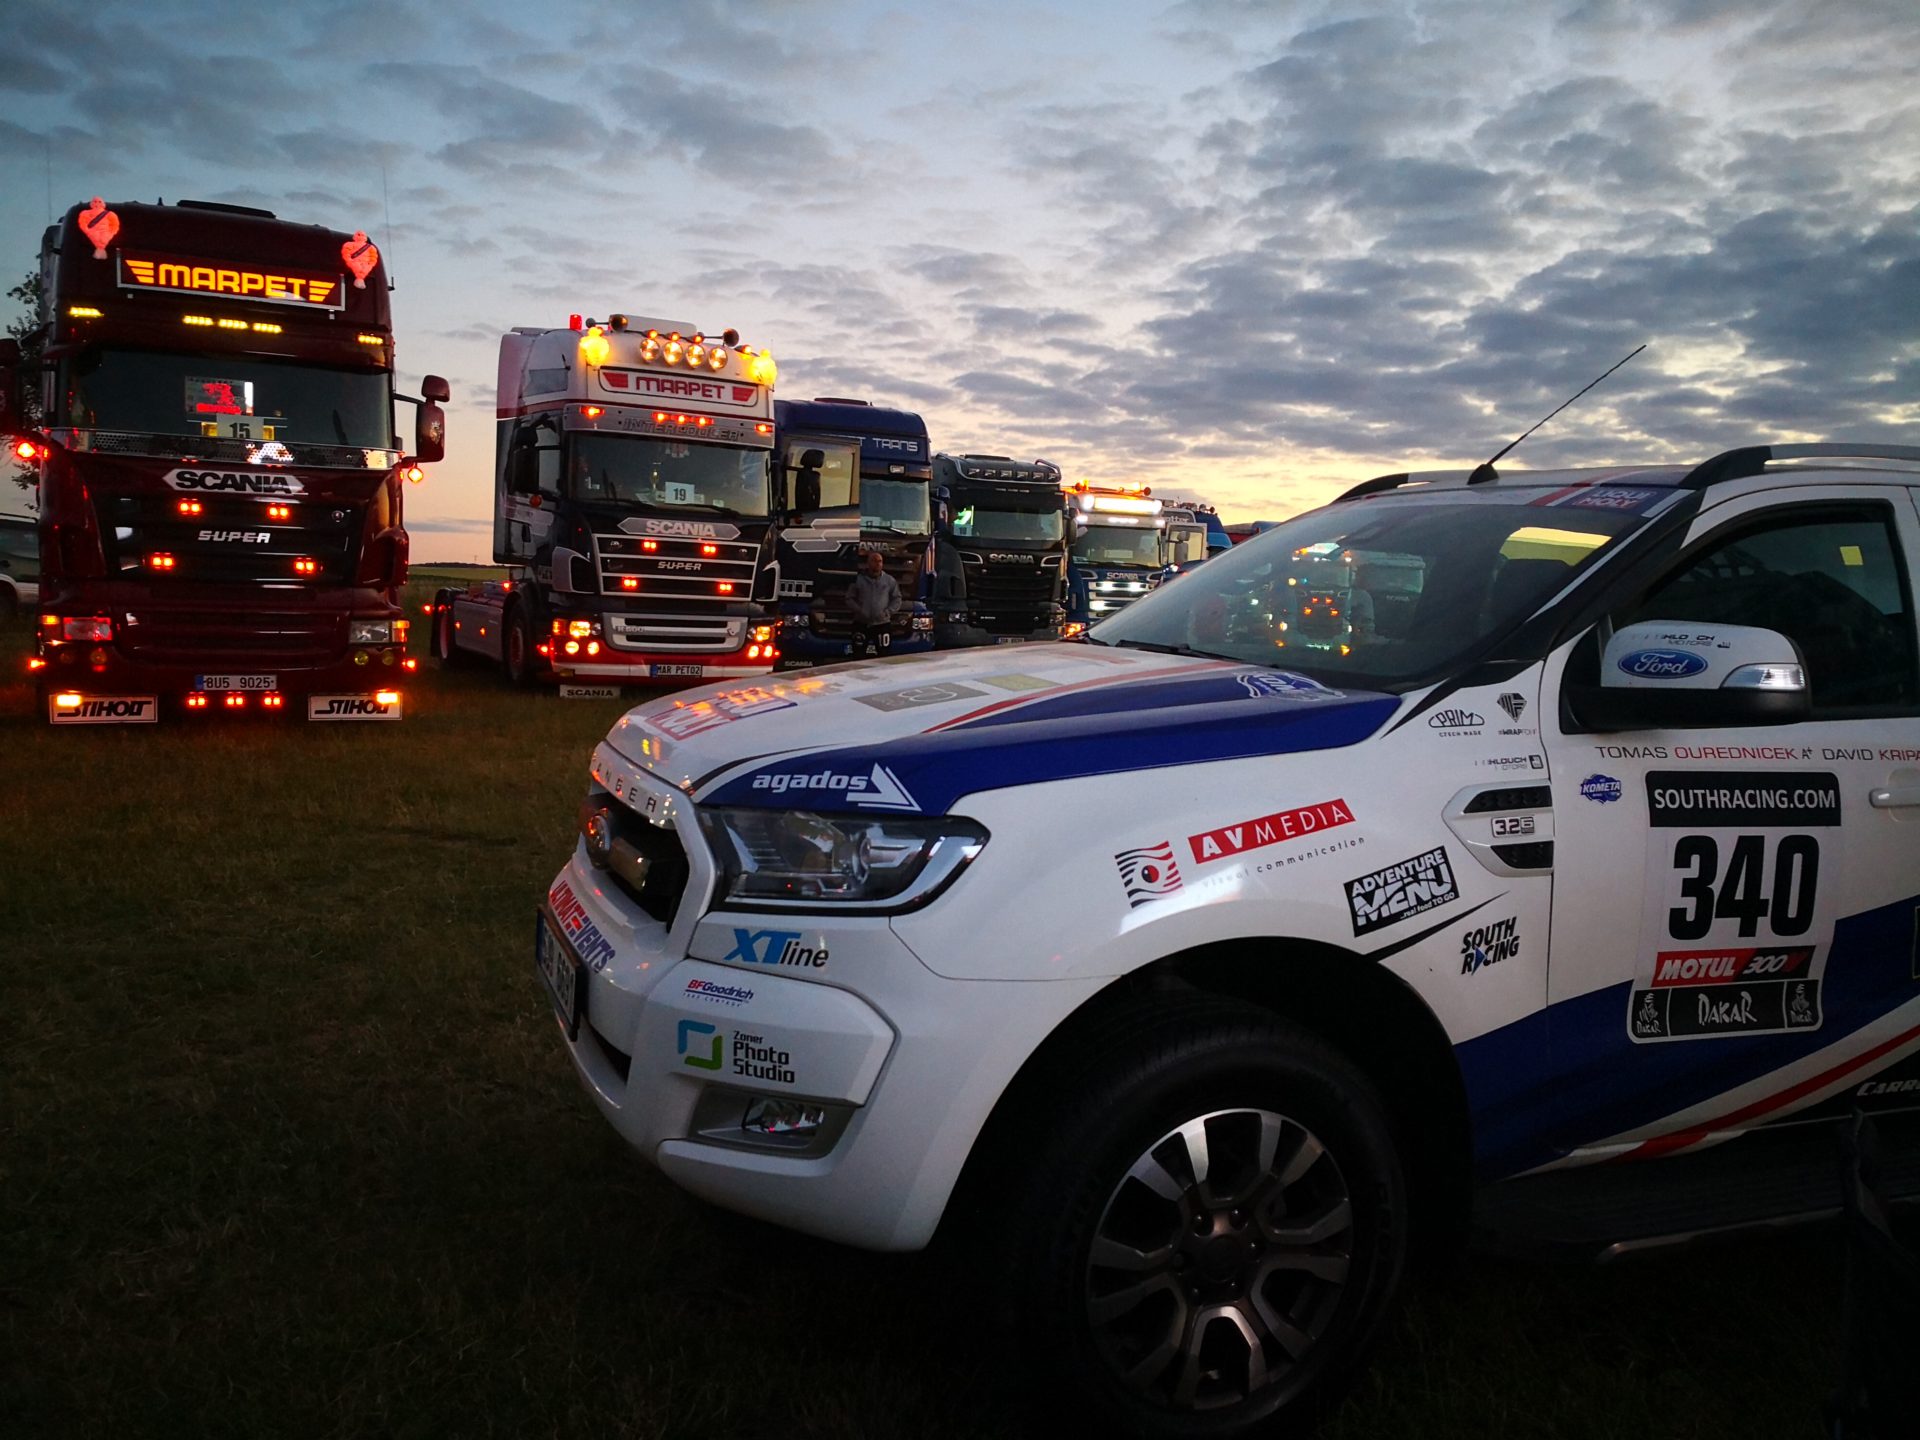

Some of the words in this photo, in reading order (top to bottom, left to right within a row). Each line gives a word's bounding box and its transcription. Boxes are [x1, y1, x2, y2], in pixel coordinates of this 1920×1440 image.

[159, 263, 306, 299] MARPET
[635, 376, 725, 399] MARPET
[229, 422, 250, 439] 15
[623, 418, 740, 442] INTERCOOLER
[872, 437, 918, 452] TRANS
[175, 470, 290, 493] SCANIA
[673, 487, 687, 501] 19
[199, 530, 271, 544] SUPER
[645, 520, 716, 537] SCANIA
[657, 560, 702, 571] SUPER
[988, 553, 1035, 565] SCANIA
[1106, 571, 1138, 581] SCANIA
[656, 665, 673, 676] MAR
[675, 665, 700, 676] PET02
[1634, 653, 1688, 674] Ford
[206, 676, 230, 690] 8U5
[239, 676, 271, 690] 9025
[567, 689, 613, 698] SCANIA
[1438, 709, 1475, 727] PRIM
[1595, 747, 1667, 759] TOMAS
[1675, 748, 1797, 760] OUREDNICEK
[1823, 749, 1874, 760] DAVID
[752, 770, 868, 793] agados
[1583, 782, 1620, 793] KOMETA
[1655, 789, 1836, 809] SOUTHRACING.COM
[1257, 837, 1365, 873] communication
[1352, 849, 1445, 897] ADVENTURE
[1353, 863, 1452, 926] MENU
[1668, 835, 1820, 941] 340
[1432, 896, 1443, 906] TO
[1443, 891, 1455, 901] GO
[1461, 916, 1517, 954] SOUTH
[1657, 957, 1737, 981] MOTUL
[687, 979, 754, 1000] BFGoodrich
[1698, 991, 1758, 1026] DAKAR
[1790, 1010, 1814, 1024] DAKAR
[1636, 1020, 1662, 1034] DAKAR
[733, 1030, 763, 1044] Zoner
[733, 1042, 790, 1065] Photo
[733, 1058, 795, 1084] Studio
[1856, 1079, 1920, 1097] CARR
